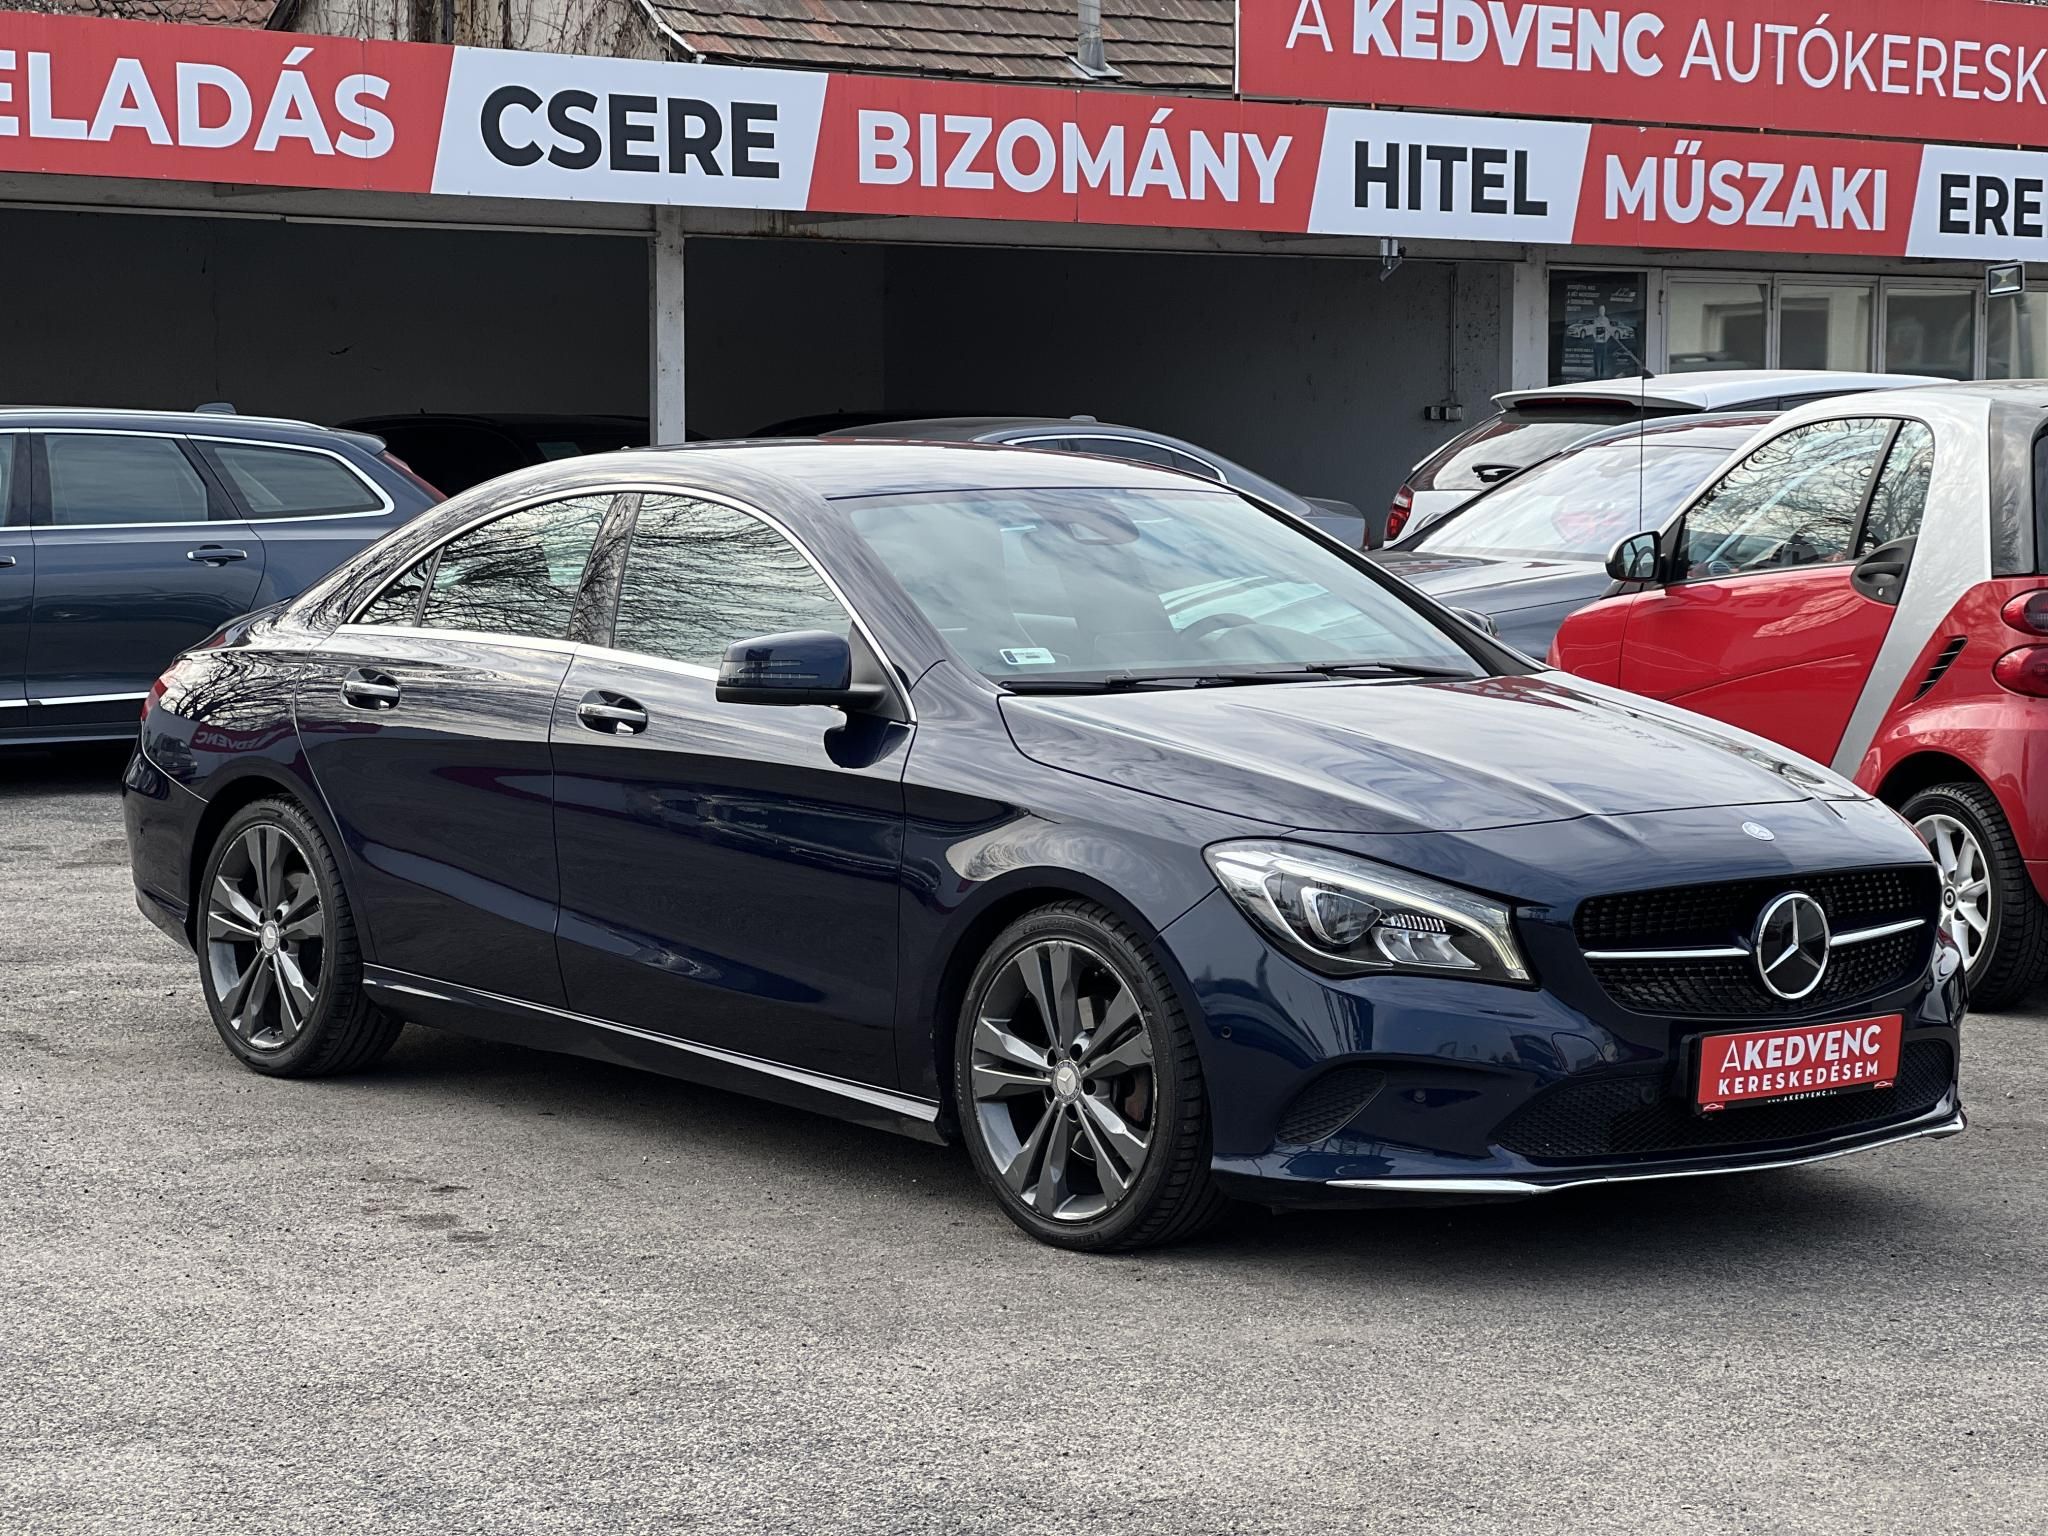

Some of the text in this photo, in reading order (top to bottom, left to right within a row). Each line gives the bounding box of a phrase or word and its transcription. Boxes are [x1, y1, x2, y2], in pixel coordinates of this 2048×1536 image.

[1285, 0, 2048, 105] A KEDVENC AUTÓKERESK
[480, 85, 780, 179] CSERE
[858, 107, 1293, 204] BIZOMÁNY
[1354, 140, 1548, 217] HITEL
[1605, 139, 1888, 231] MŰSZAKI
[1939, 173, 2044, 238] ERE
[1718, 1060, 1879, 1096] KERESKEDÉSEM
